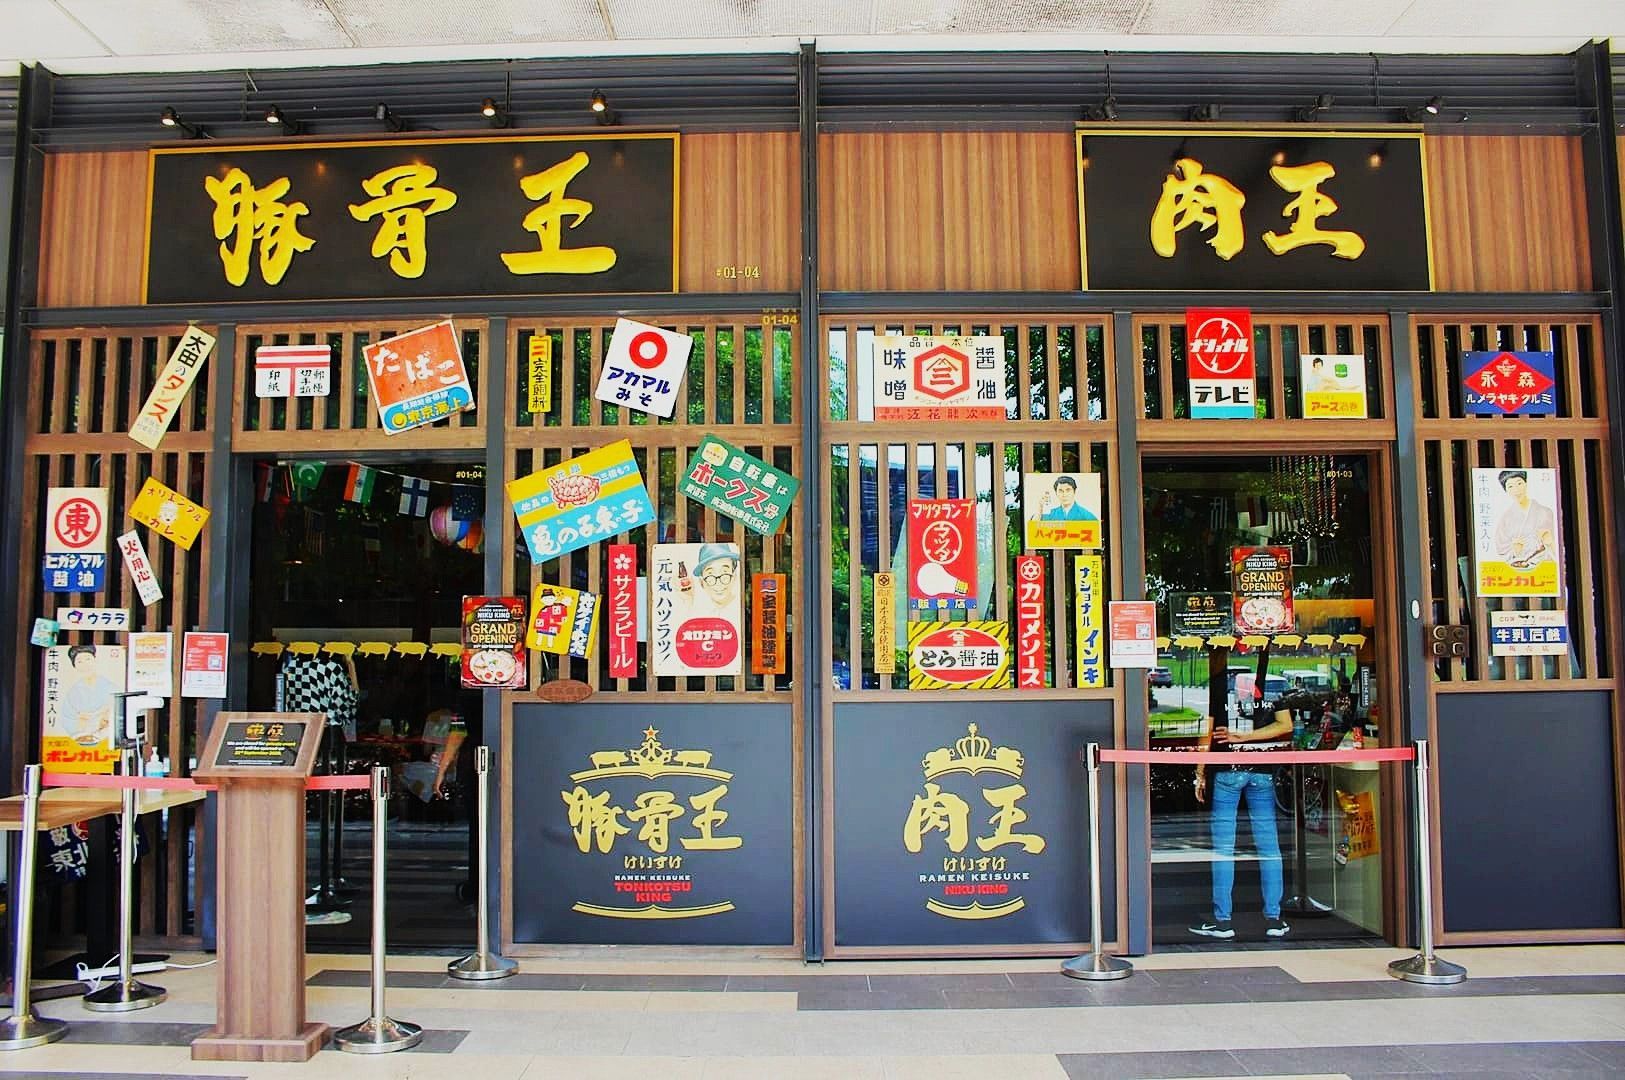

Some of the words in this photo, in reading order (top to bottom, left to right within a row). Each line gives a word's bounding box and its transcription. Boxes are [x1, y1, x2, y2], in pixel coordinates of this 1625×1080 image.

[1150, 157, 1366, 261] 肉王
[205, 150, 618, 287] 豚骨王
[716, 265, 761, 280] #01-04
[1189, 337, 1249, 353] ナショナル
[373, 346, 460, 385] たばこ
[883, 348, 907, 400] 味噌
[148, 335, 206, 424] 太田のタンス
[268, 369, 281, 392] 印紙
[606, 365, 671, 394] アカマル
[616, 387, 652, 407] みそ
[1195, 386, 1249, 404] テレビ
[408, 398, 462, 425] 東京海上
[147, 487, 202, 522] オリエンタル
[911, 501, 975, 519] マツダランプ
[62, 504, 93, 541] 東
[150, 518, 189, 542] カレー
[1035, 528, 1093, 542] ハイアース
[45, 554, 106, 570] ヒガシマル
[123, 538, 151, 584] 火の用心
[1240, 572, 1285, 582] GRAND
[1481, 575, 1556, 588] ボンカレー
[1240, 582, 1285, 591] OPENING
[87, 612, 126, 625] ウララ
[613, 575, 633, 669] サクラビール
[470, 622, 517, 634] GRAND
[470, 634, 517, 644] OPENING
[701, 641, 714, 652] C
[919, 648, 999, 668] とら醤油
[45, 750, 121, 763] ボンカレー
[560, 784, 743, 854] 豚骨王
[903, 783, 1046, 854] 肉王
[624, 855, 682, 870] けいすけ
[943, 856, 1007, 871] けいすけ
[919, 873, 965, 883] RAMEN
[971, 872, 1030, 881] KEISUKE
[614, 882, 692, 892] TONKOTSU
[944, 885, 975, 895] NIKU
[977, 884, 1009, 895] KING
[635, 893, 673, 902] KING
